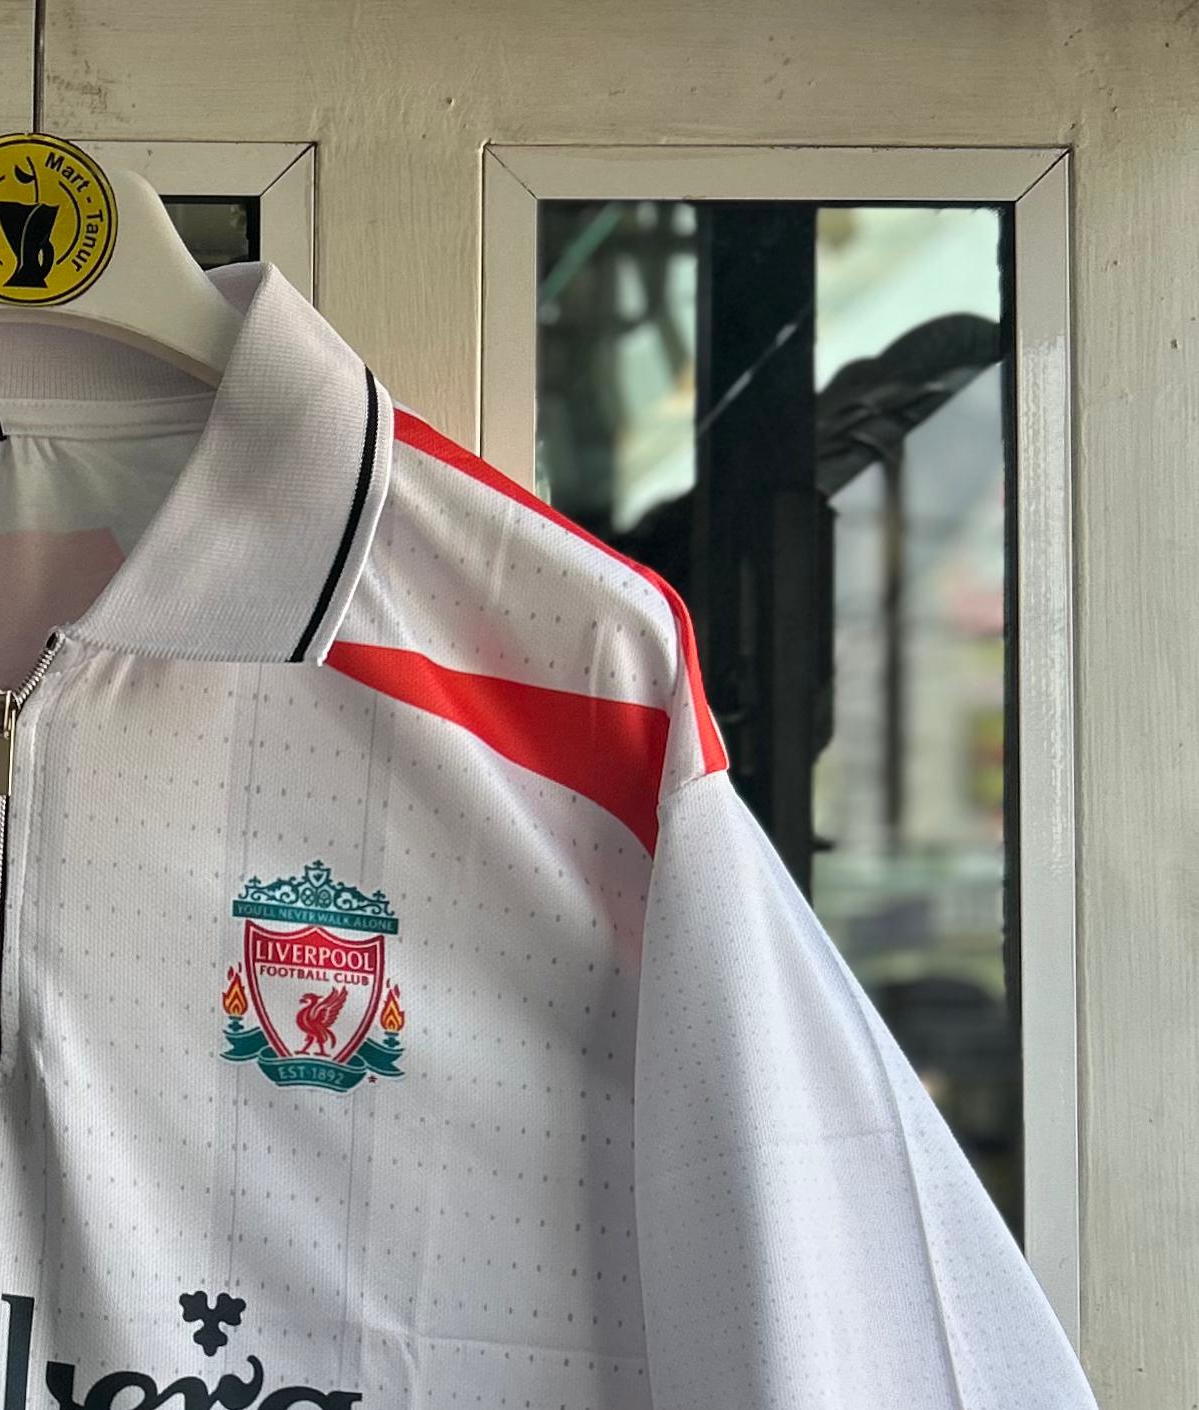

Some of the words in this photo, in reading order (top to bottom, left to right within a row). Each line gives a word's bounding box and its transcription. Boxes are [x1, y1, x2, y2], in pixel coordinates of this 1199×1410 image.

[45, 151, 91, 193] Mart
[71, 209, 104, 273] Tanur
[278, 906, 318, 922] NEVER
[317, 911, 350, 926] WALK
[353, 916, 394, 931] ALONE
[255, 940, 374, 971] LIVERPOOL
[259, 964, 329, 983] FOOTBALL
[333, 971, 370, 987] CLUB
[277, 1065, 306, 1080] EST
[311, 1067, 345, 1085] 1892
